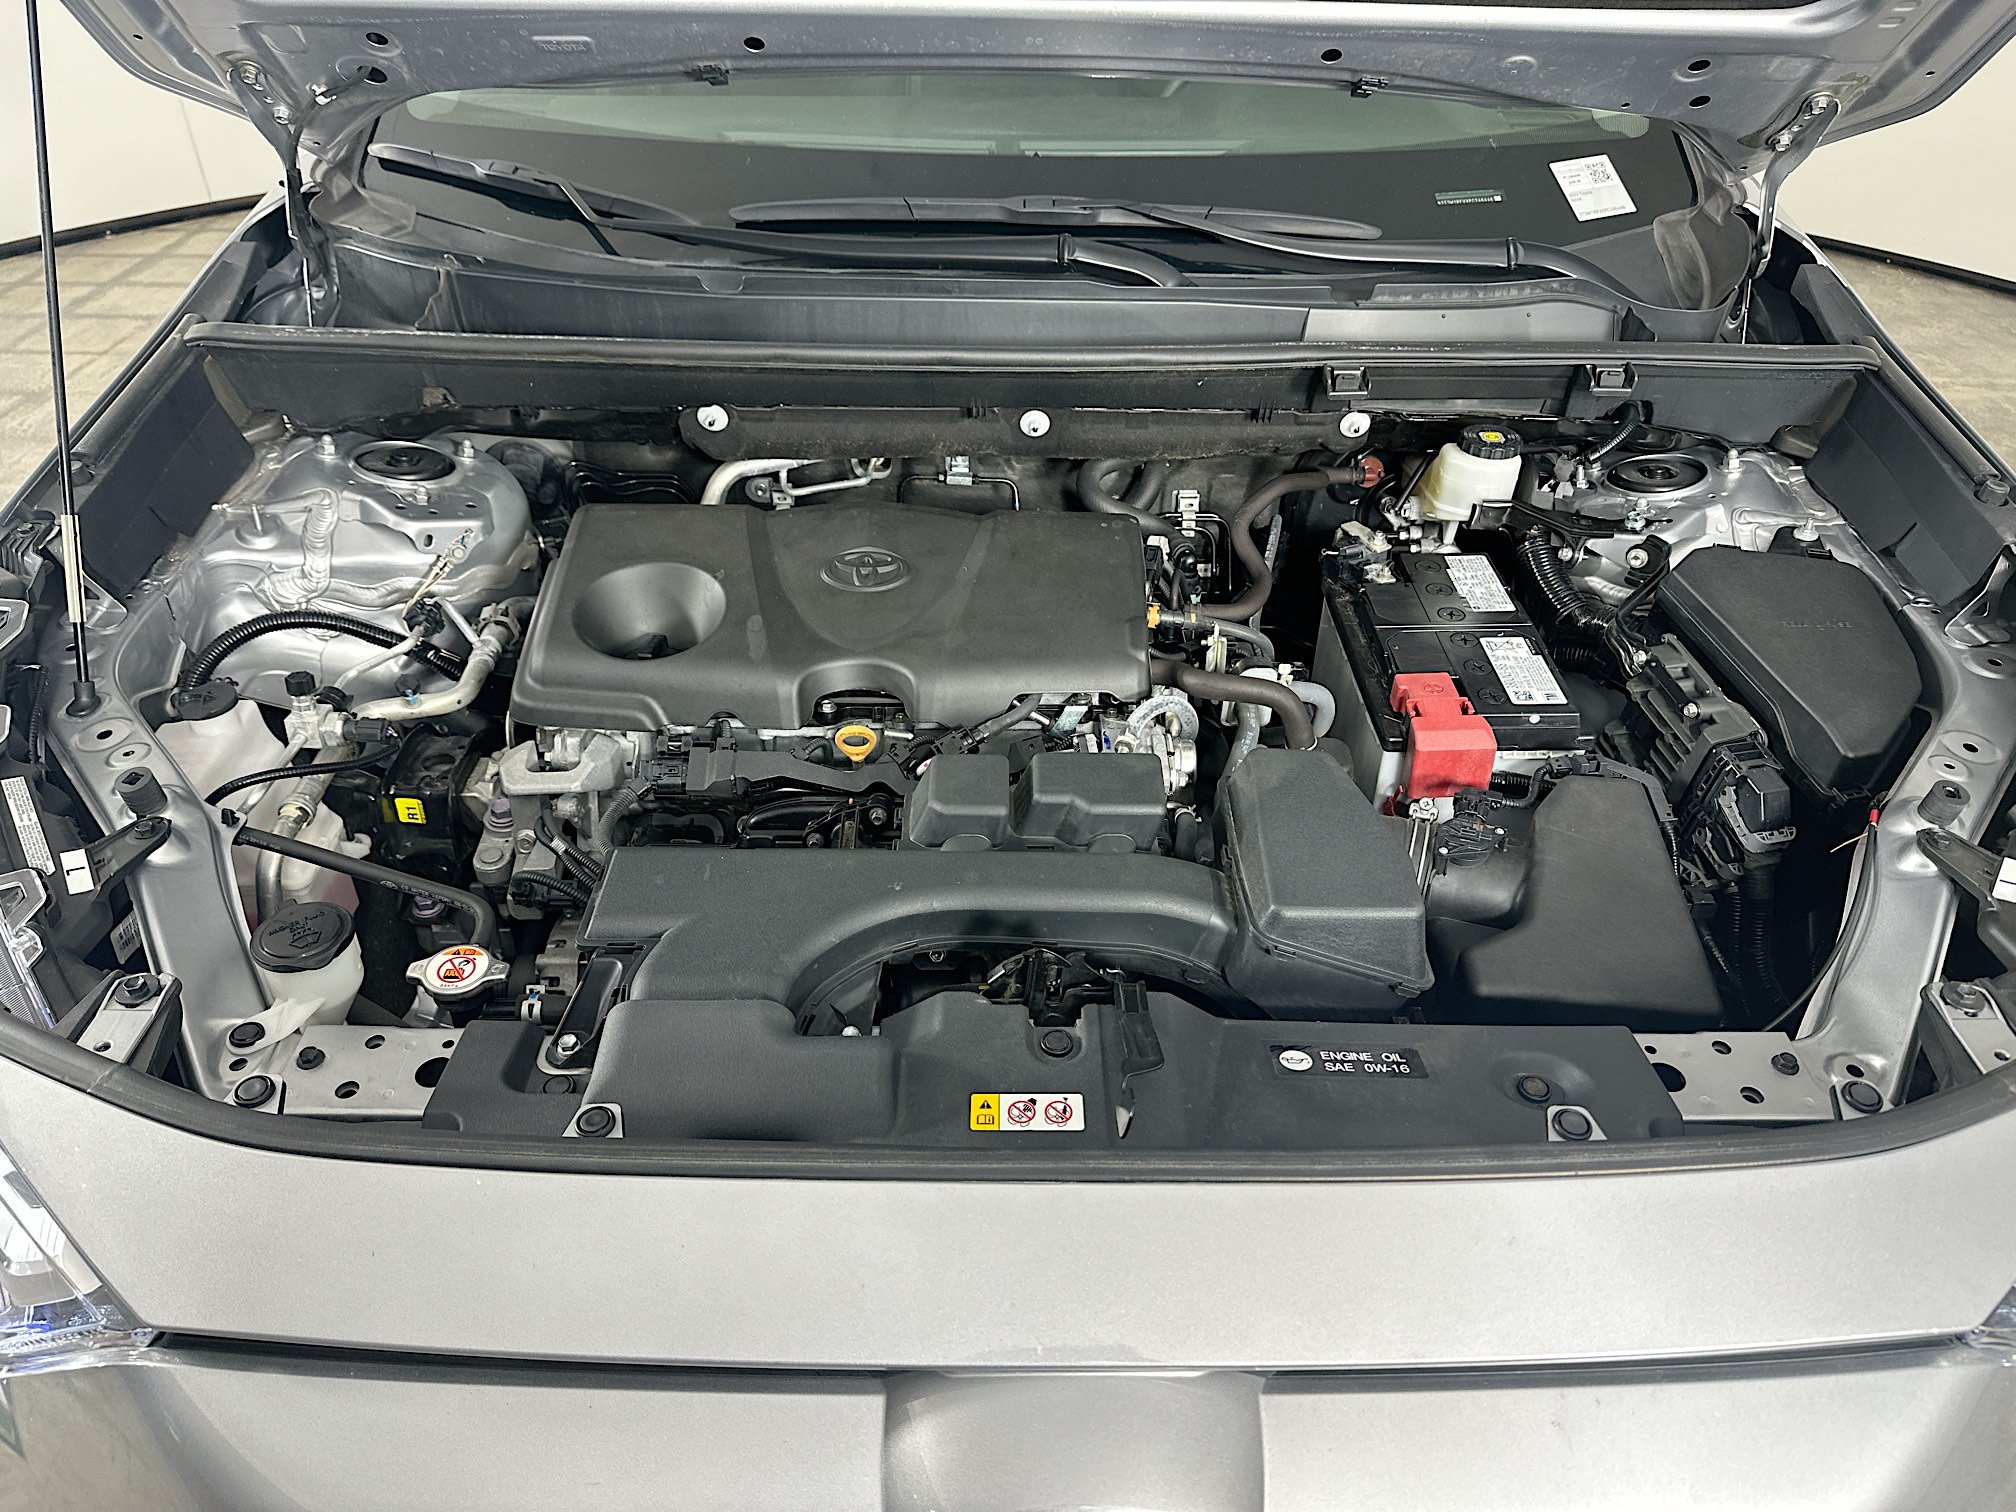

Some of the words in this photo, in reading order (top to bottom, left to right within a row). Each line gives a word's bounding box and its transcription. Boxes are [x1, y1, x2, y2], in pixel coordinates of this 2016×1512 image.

[541, 43, 587, 51] TOYOTA
[406, 806, 419, 820] R1
[1319, 1050, 1373, 1062] ENGINE
[1381, 1052, 1407, 1062] OIL
[1324, 1062, 1355, 1072] SAE
[1364, 1063, 1410, 1074] 0W-16
